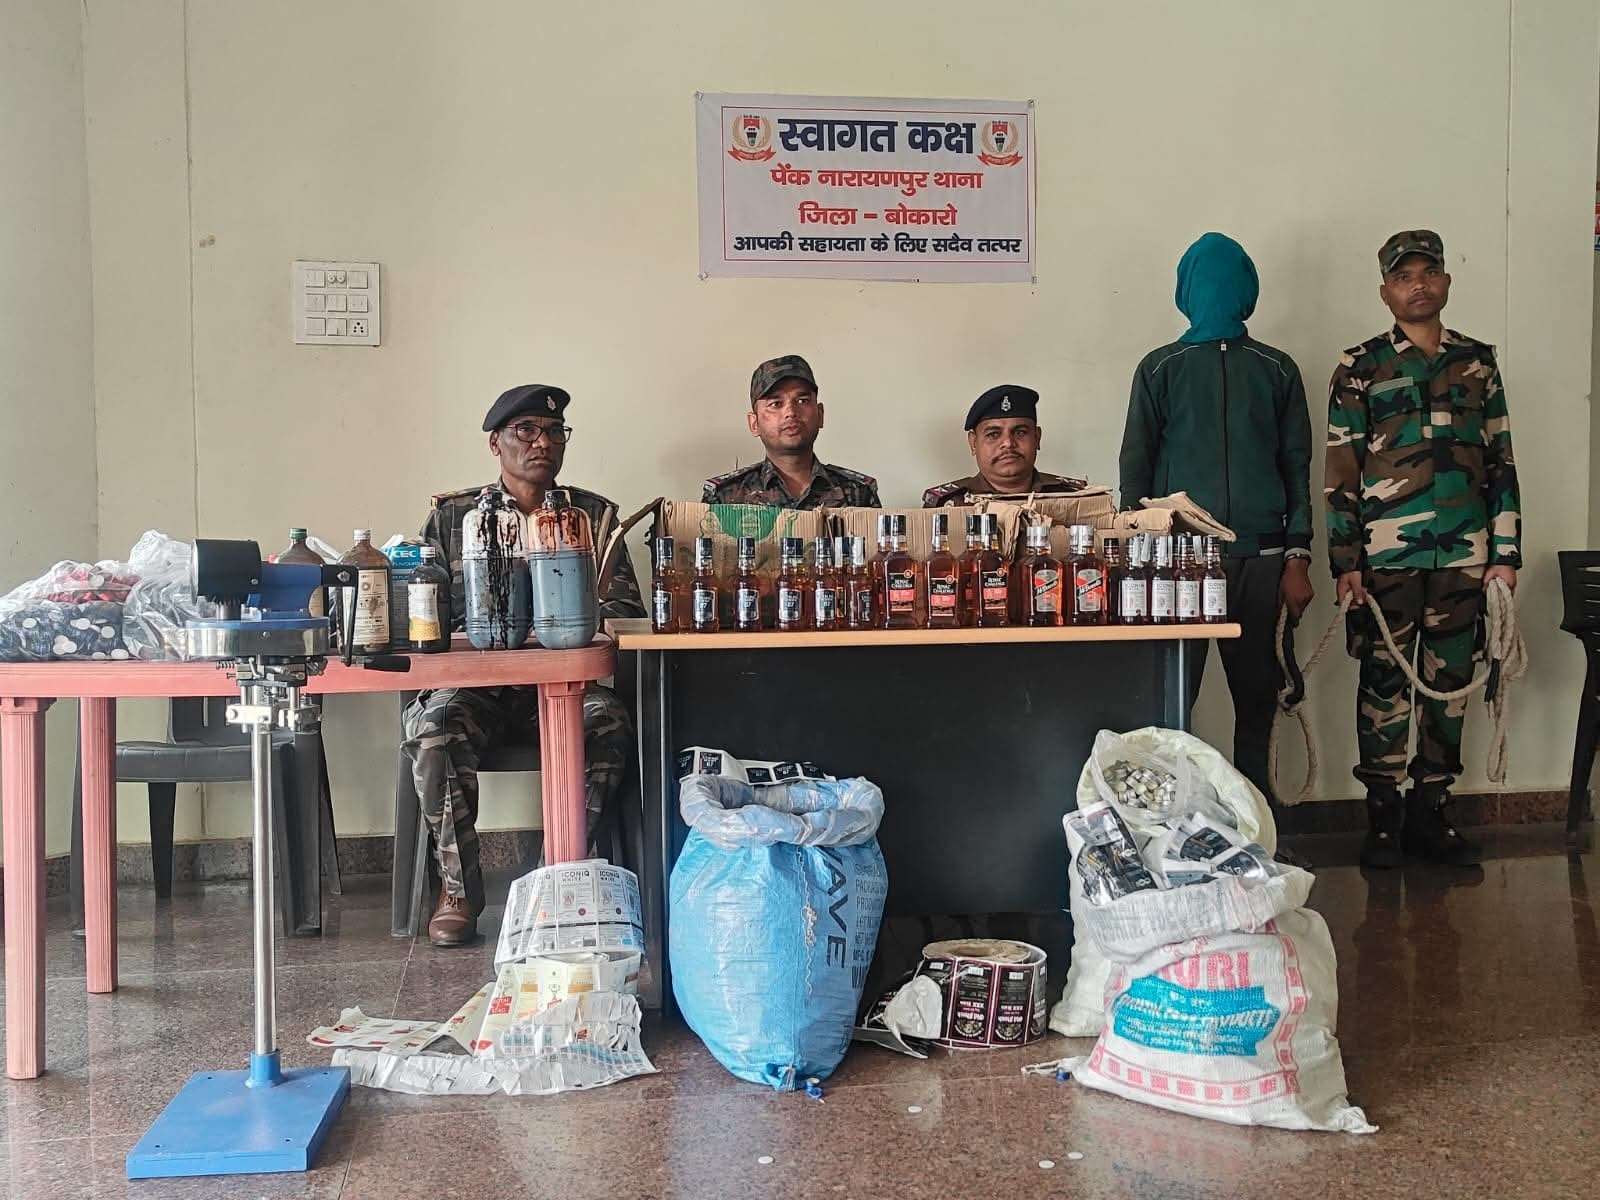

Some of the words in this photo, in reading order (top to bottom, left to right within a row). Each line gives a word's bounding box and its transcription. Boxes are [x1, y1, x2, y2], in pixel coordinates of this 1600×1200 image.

[778, 119, 898, 153] स्वागत
[906, 121, 977, 154] कक्ष
[770, 163, 812, 187] पेंक
[817, 169, 929, 196] नारायणपुर
[932, 172, 984, 189] थाना
[797, 201, 857, 225] जिला
[884, 202, 958, 226] बोकारो
[734, 231, 794, 251] आपकी
[798, 236, 866, 253] सहायता
[870, 233, 890, 252] के
[894, 232, 928, 253] लिए
[932, 233, 973, 253] सदैव
[977, 238, 1022, 253] तत्पर
[561, 870, 590, 878] ICONIQ
[599, 870, 620, 878] ICONIQ
